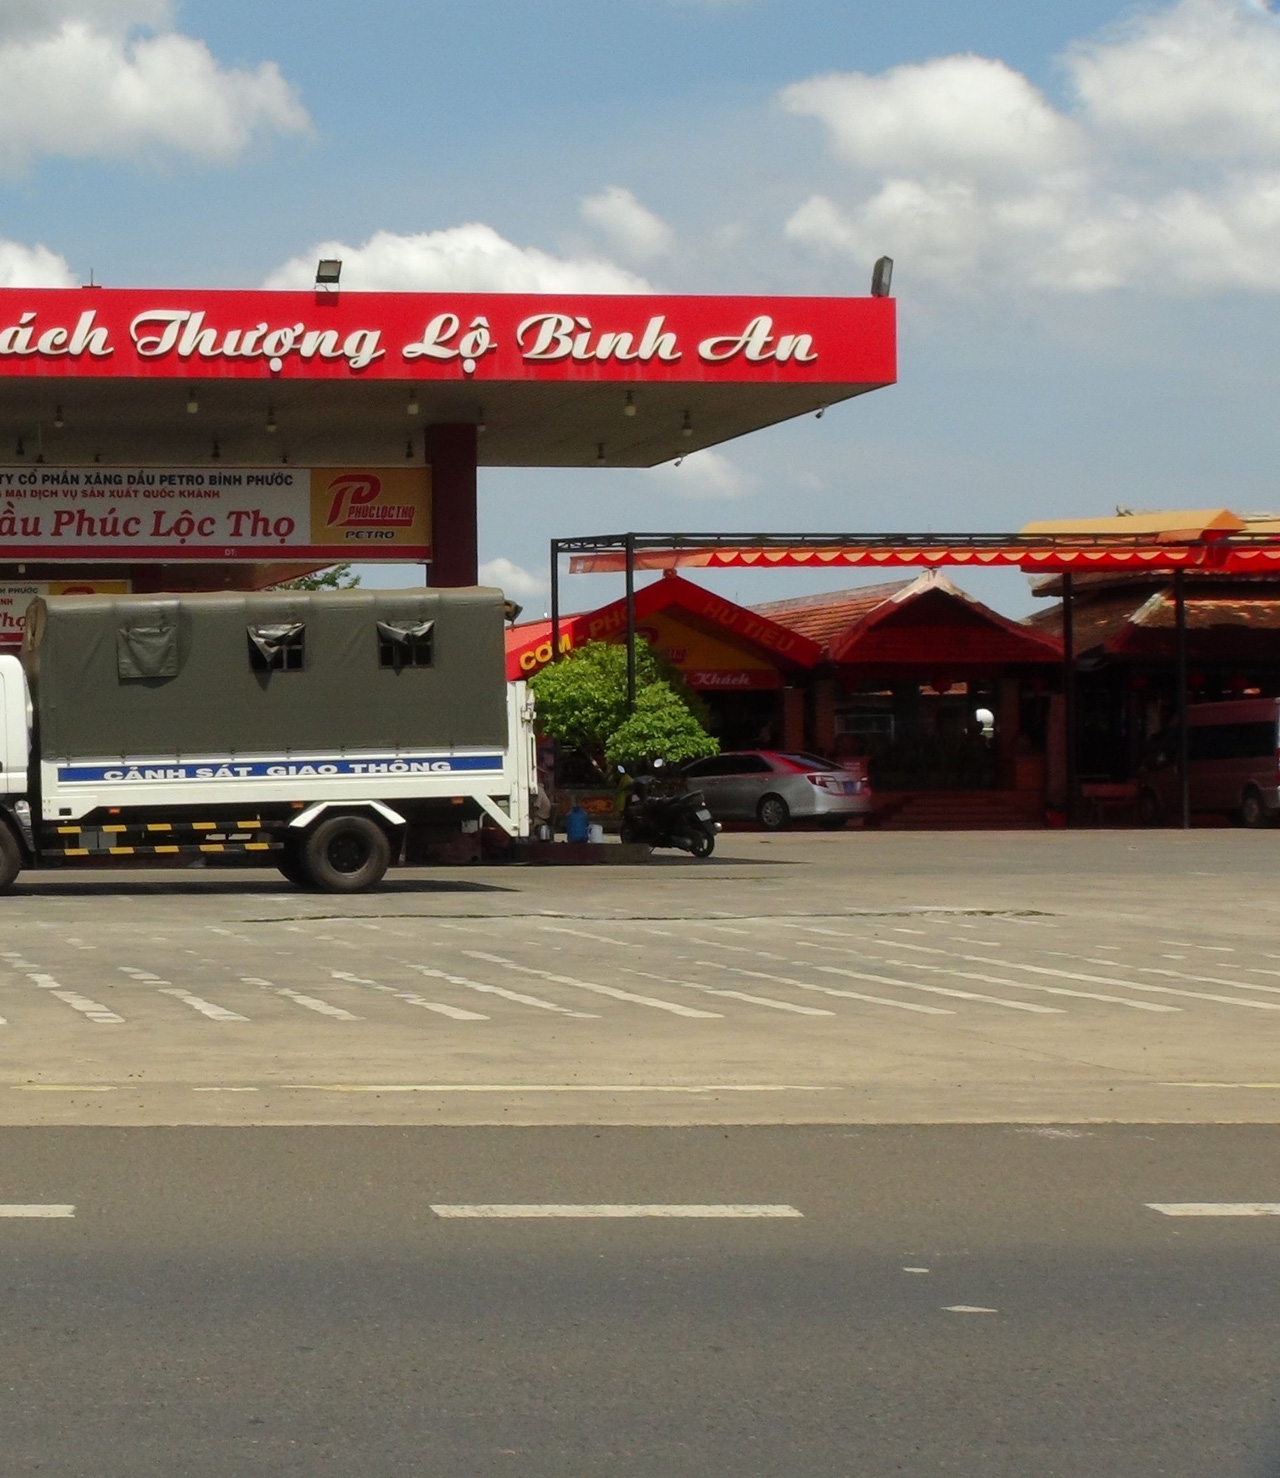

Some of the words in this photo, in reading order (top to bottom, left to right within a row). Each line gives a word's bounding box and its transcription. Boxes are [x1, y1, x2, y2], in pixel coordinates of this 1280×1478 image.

[129, 309, 386, 373] Thượng
[402, 313, 498, 374] Lộ
[516, 313, 682, 361] Bình
[697, 314, 819, 363] An
[19, 469, 38, 485] CỔ
[41, 470, 80, 485] PHẦN
[127, 470, 155, 486] DẦU
[159, 474, 205, 486] PETRO
[208, 472, 243, 486] BÌNH
[246, 472, 294, 486] PHƯỚC
[5, 489, 27, 501] MẠI
[30, 489, 58, 500] DỊCH
[63, 490, 78, 501] VỤ
[81, 487, 105, 498] SẢN
[143, 486, 175, 499] QUỐC
[179, 487, 220, 499] KHÁNH
[50, 507, 142, 537] Phúc
[150, 509, 217, 544] Lộc
[226, 509, 295, 544] Thọ
[345, 530, 395, 539] PETRO
[103, 762, 187, 781] CẢNH
[196, 762, 253, 779] SÁT
[266, 764, 339, 777] GIAO
[349, 759, 452, 774] THÔNG
